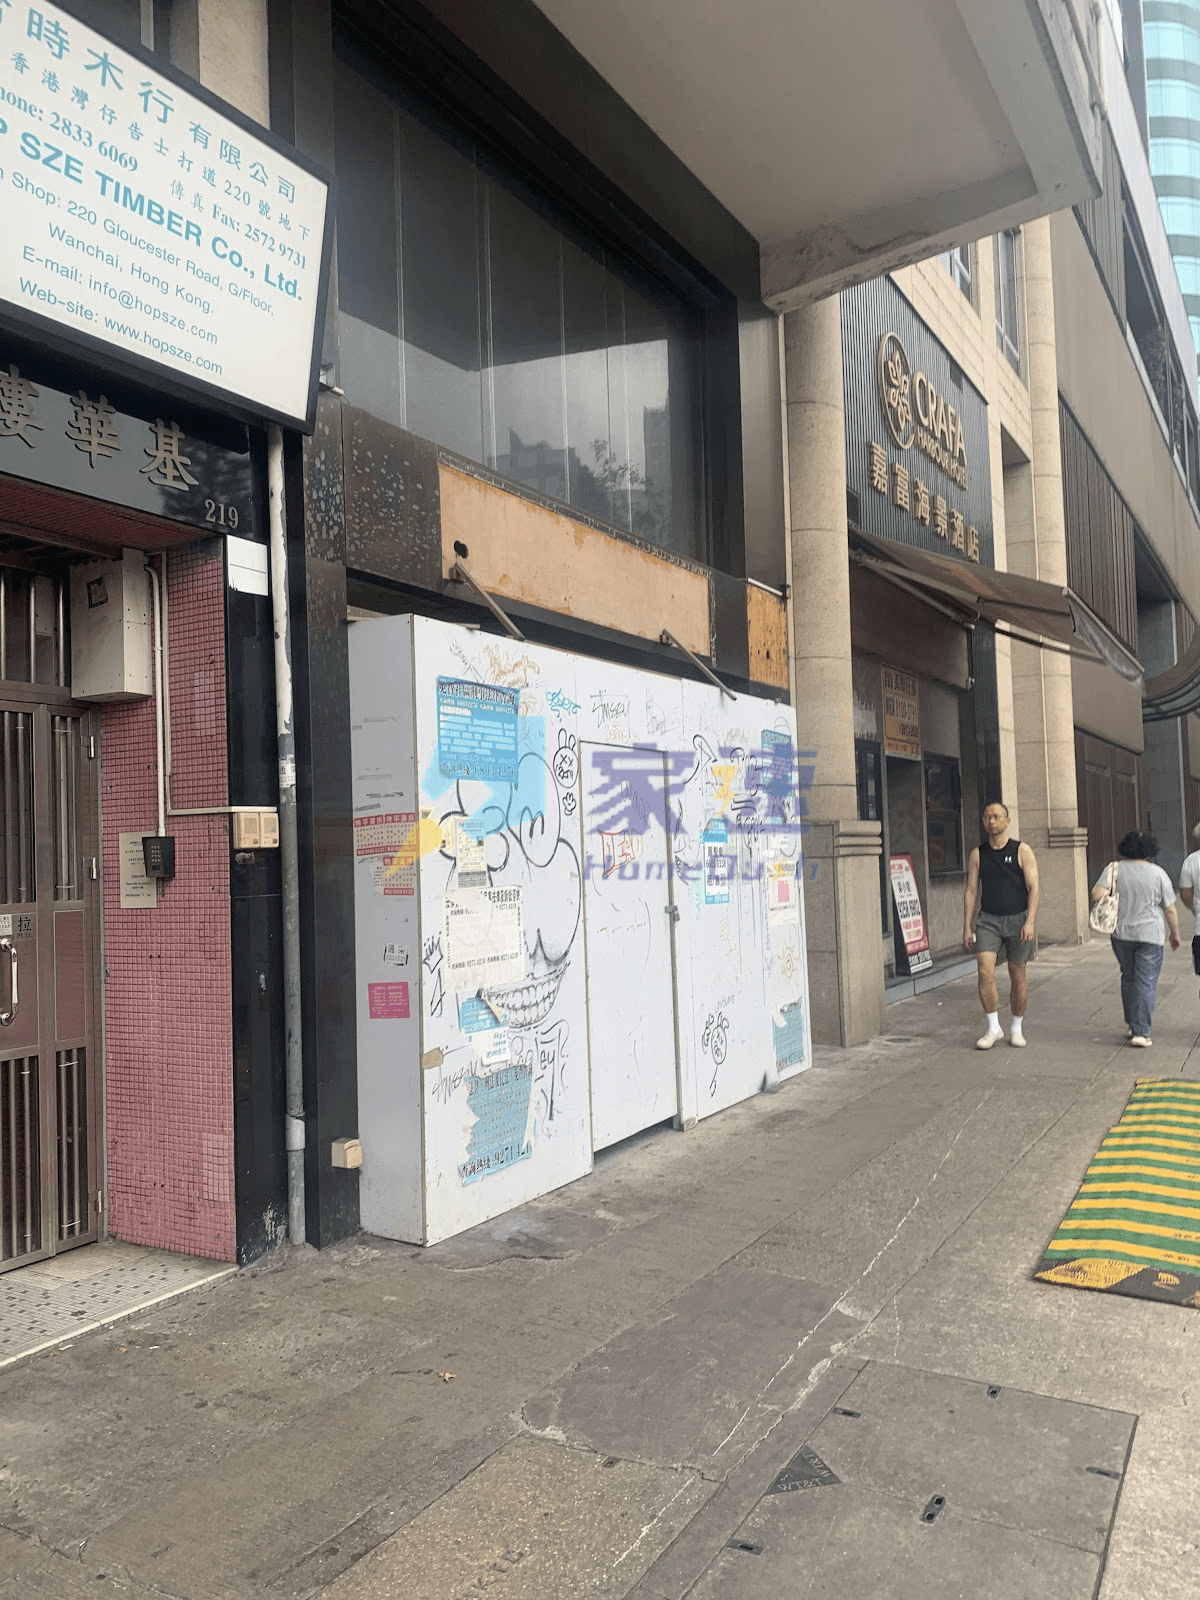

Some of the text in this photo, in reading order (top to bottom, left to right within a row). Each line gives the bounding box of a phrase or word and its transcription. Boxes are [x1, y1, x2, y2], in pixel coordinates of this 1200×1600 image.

[0, 0, 296, 204] 時木行 有限公司
[49, 111, 93, 149] 2833
[97, 140, 139, 173] 6069
[11, 171, 274, 317] Shop: 220 Gloucester Road, G/Floor,
[20, 131, 303, 301] SZE TIMBER Co., Ltd.
[169, 179, 307, 271] 傳真 Fax: 2572 9731
[22, 245, 219, 345] E-mail: info@hopsze.com
[48, 222, 215, 315] Wanchai, Hong Kong.
[19, 276, 224, 376] Web-site: www.hopsze.com
[912, 371, 968, 466] CRAFA
[204, 499, 239, 529] 219
[17, 916, 32, 932] 拉
